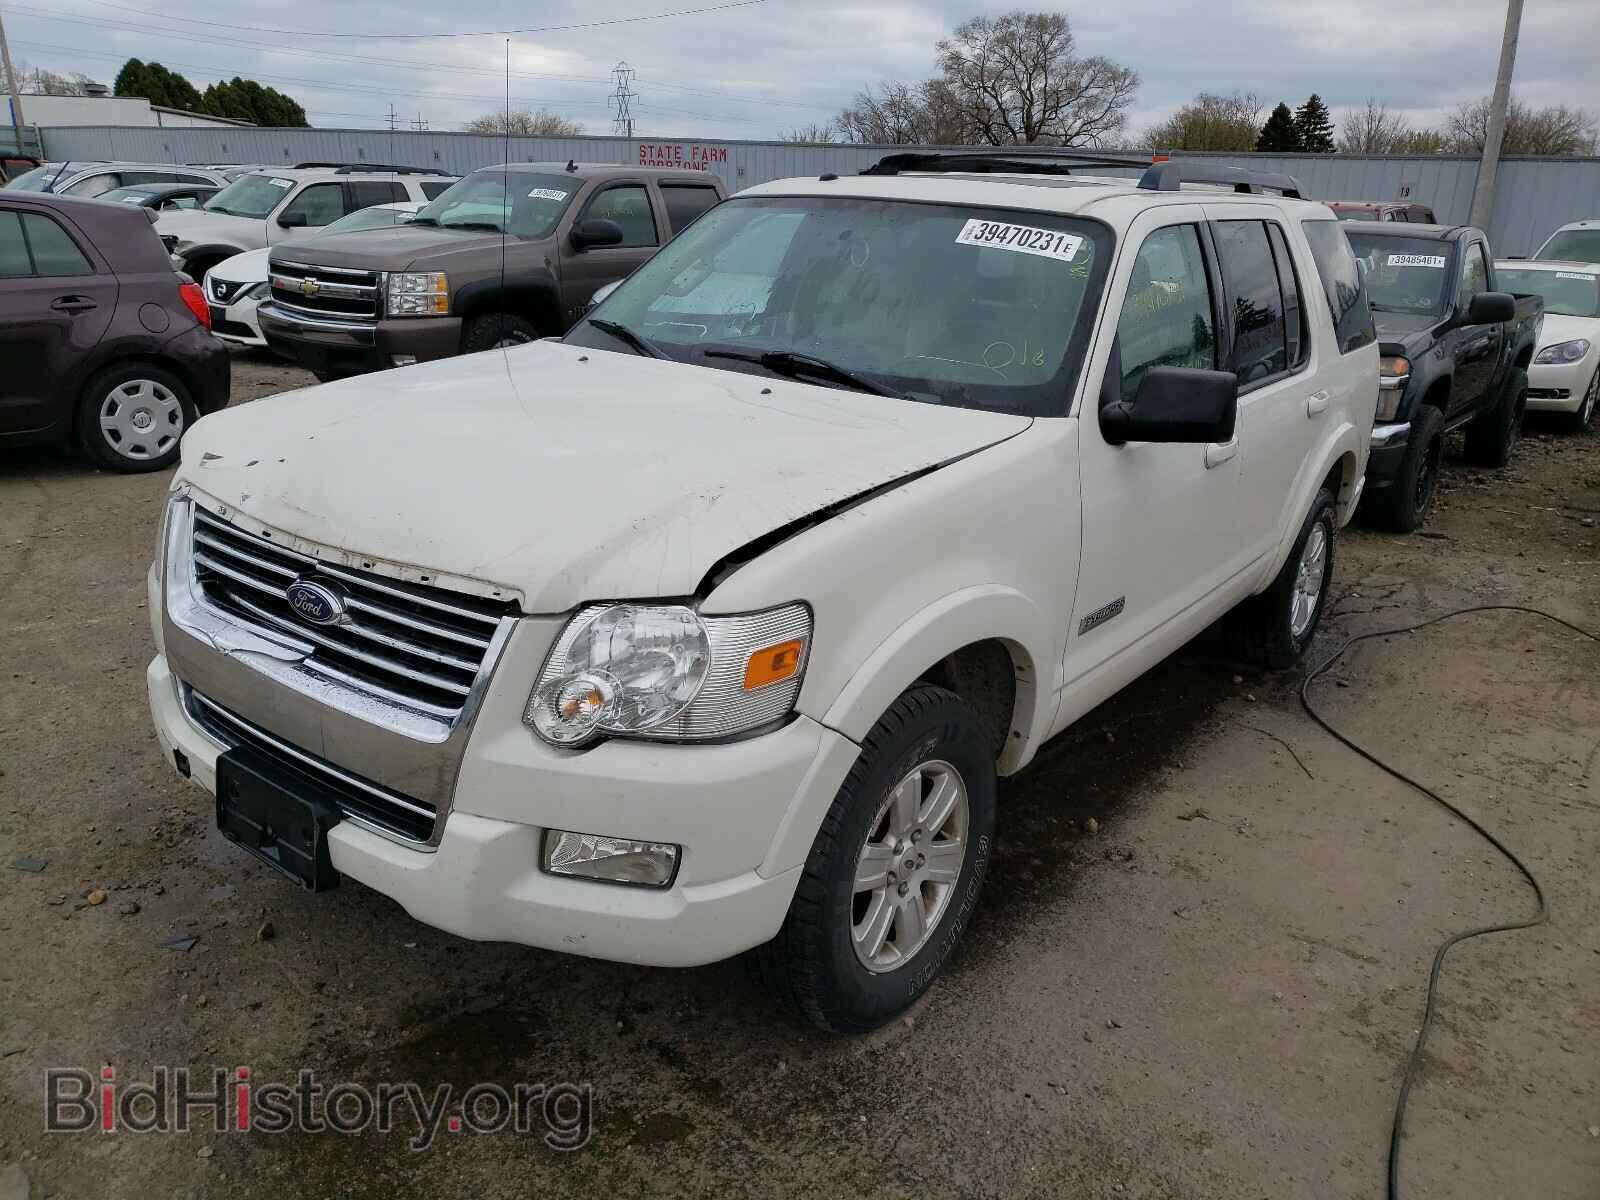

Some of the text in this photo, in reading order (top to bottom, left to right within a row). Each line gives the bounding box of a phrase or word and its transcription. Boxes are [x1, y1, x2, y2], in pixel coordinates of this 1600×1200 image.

[639, 144, 727, 162] STATE FARM
[974, 221, 1065, 253] 39470231
[294, 589, 323, 616] Ford
